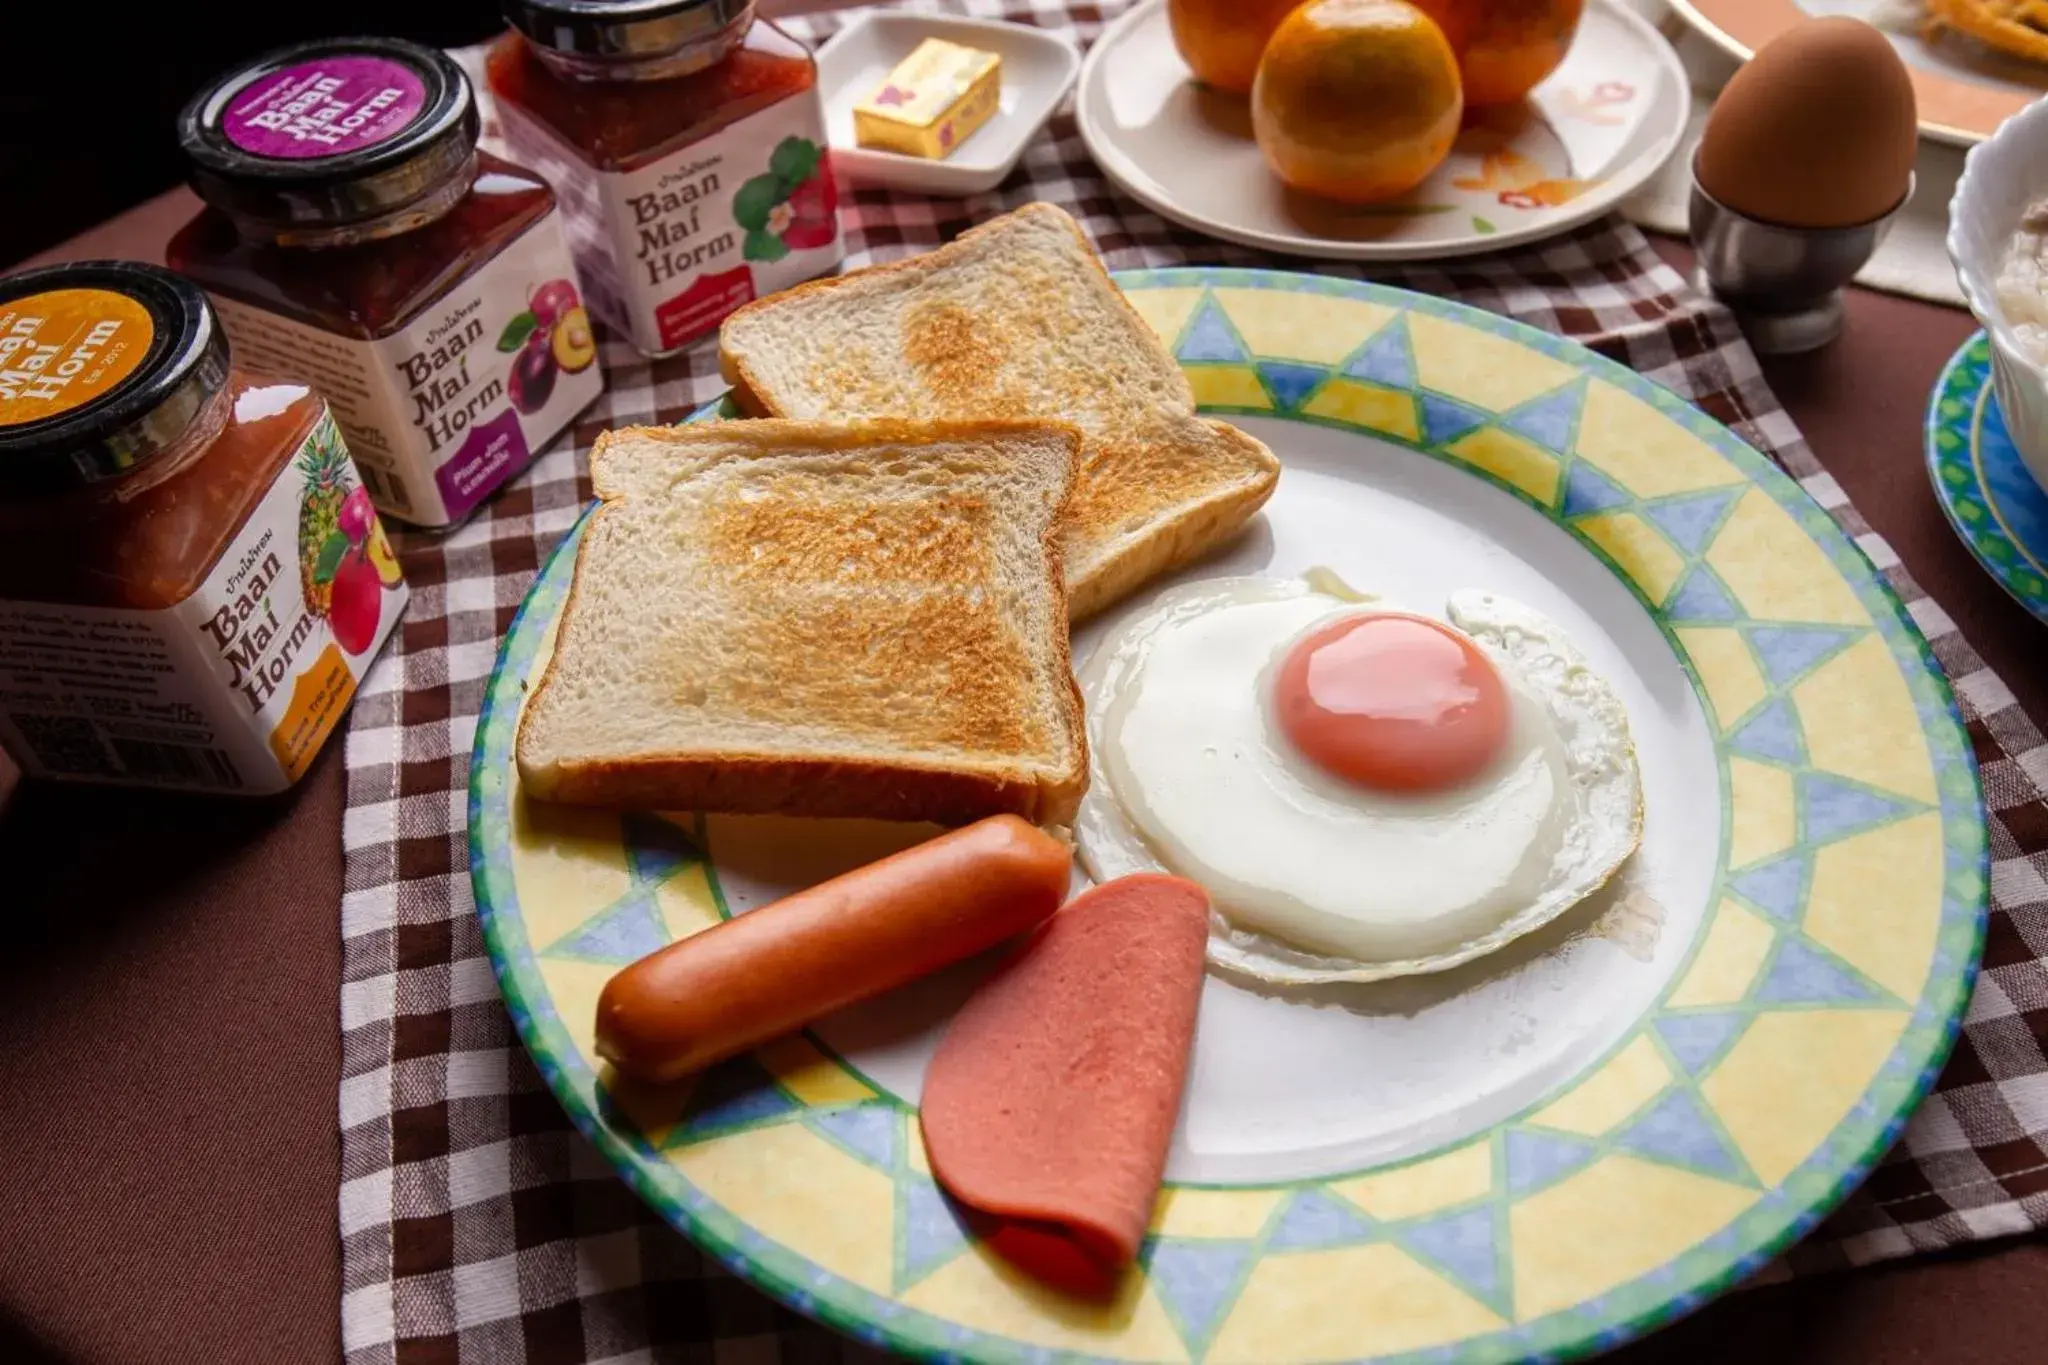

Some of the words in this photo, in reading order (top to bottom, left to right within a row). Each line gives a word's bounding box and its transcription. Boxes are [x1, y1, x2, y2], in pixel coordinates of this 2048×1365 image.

[245, 77, 344, 131] Baan
[280, 96, 350, 140] Mai
[309, 88, 404, 145] Horm
[626, 172, 720, 226] Baan
[637, 205, 701, 258] Mai
[645, 231, 735, 286] Horm
[20, 319, 124, 400] Horm
[396, 317, 484, 391] Baan
[411, 353, 471, 426] Mai
[423, 378, 504, 452] Horm
[200, 551, 282, 652] Baan
[224, 596, 281, 688] Mai
[241, 611, 314, 715] Horm
